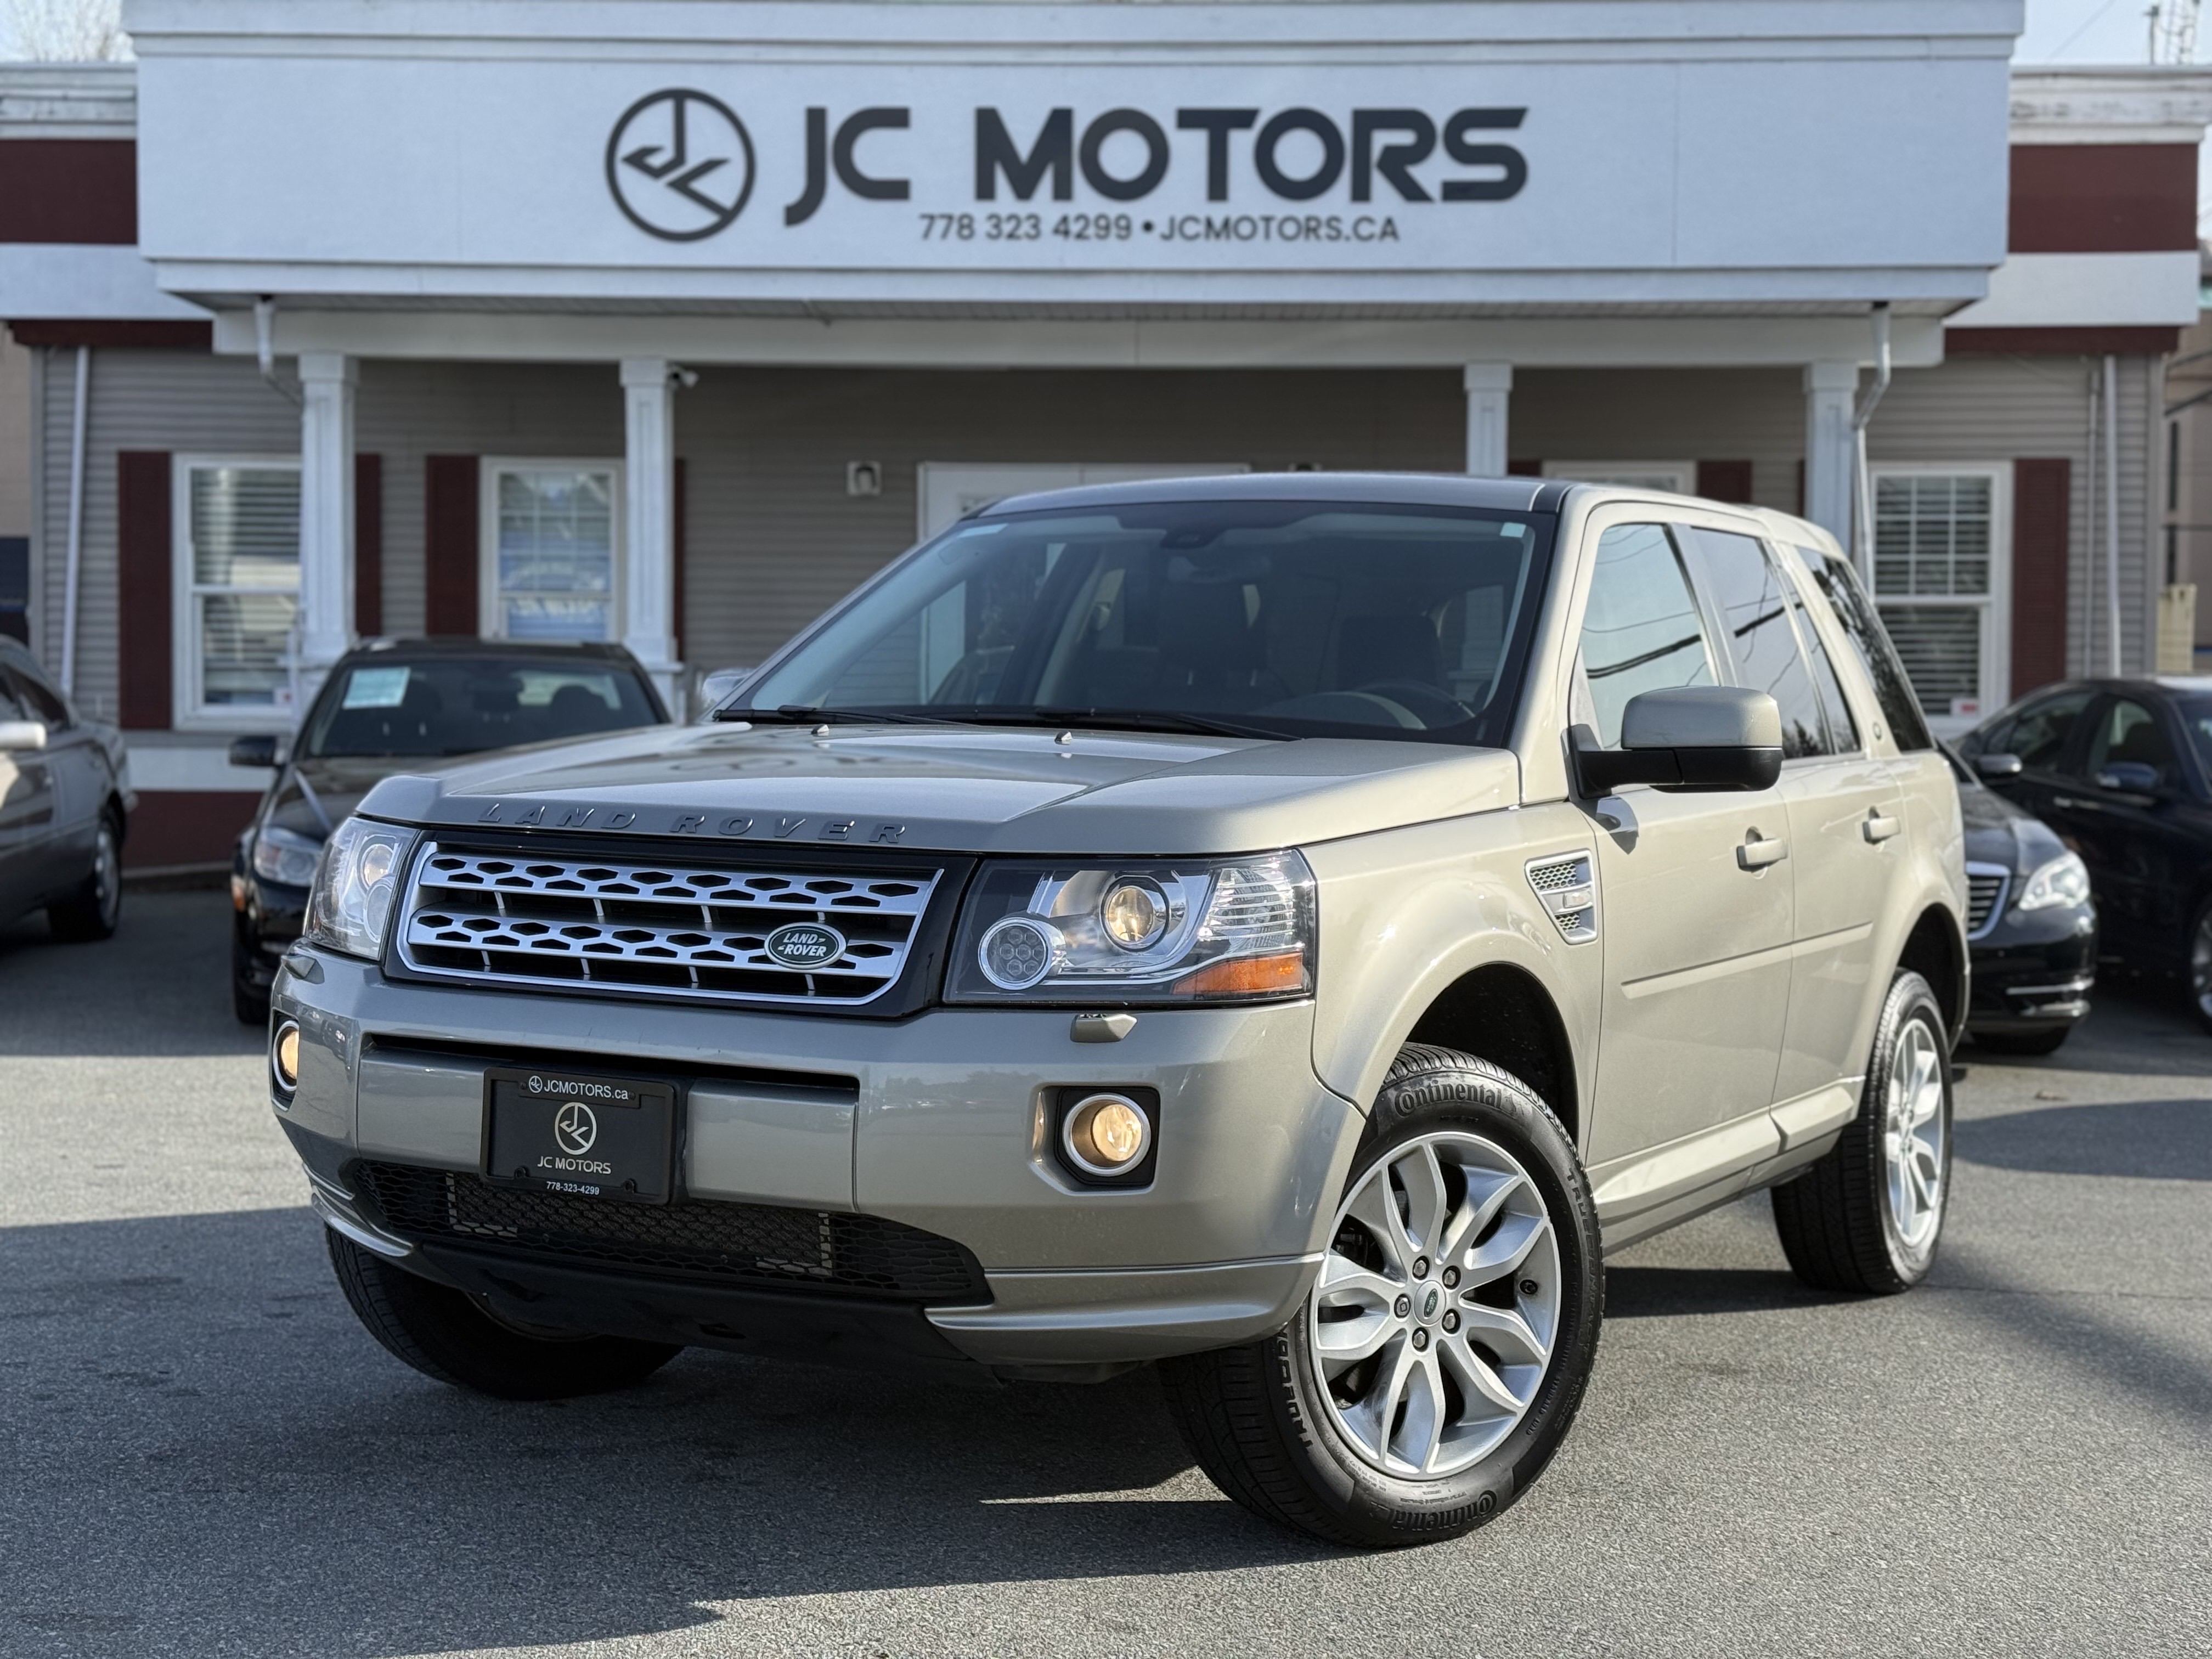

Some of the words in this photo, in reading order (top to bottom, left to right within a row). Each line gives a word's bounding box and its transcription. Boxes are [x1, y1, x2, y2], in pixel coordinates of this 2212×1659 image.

[784, 107, 911, 227] JC
[975, 107, 1528, 203] MOTORS
[919, 213, 976, 241] 778
[986, 213, 1042, 241] 323
[1052, 213, 1133, 241] 4299
[1160, 215, 1401, 242] JCMOTORS.CA
[477, 803, 637, 829] LAND
[669, 814, 906, 844] ROVER
[783, 933, 819, 944] LAND
[783, 944, 827, 957] ROVER
[544, 1080, 629, 1101] JCMOTORS.ca
[1394, 1079, 1502, 1117] Continental
[537, 1156, 552, 1169] JC
[555, 1158, 612, 1175] MOTORS
[546, 1181, 600, 1196] 778-323-4299
